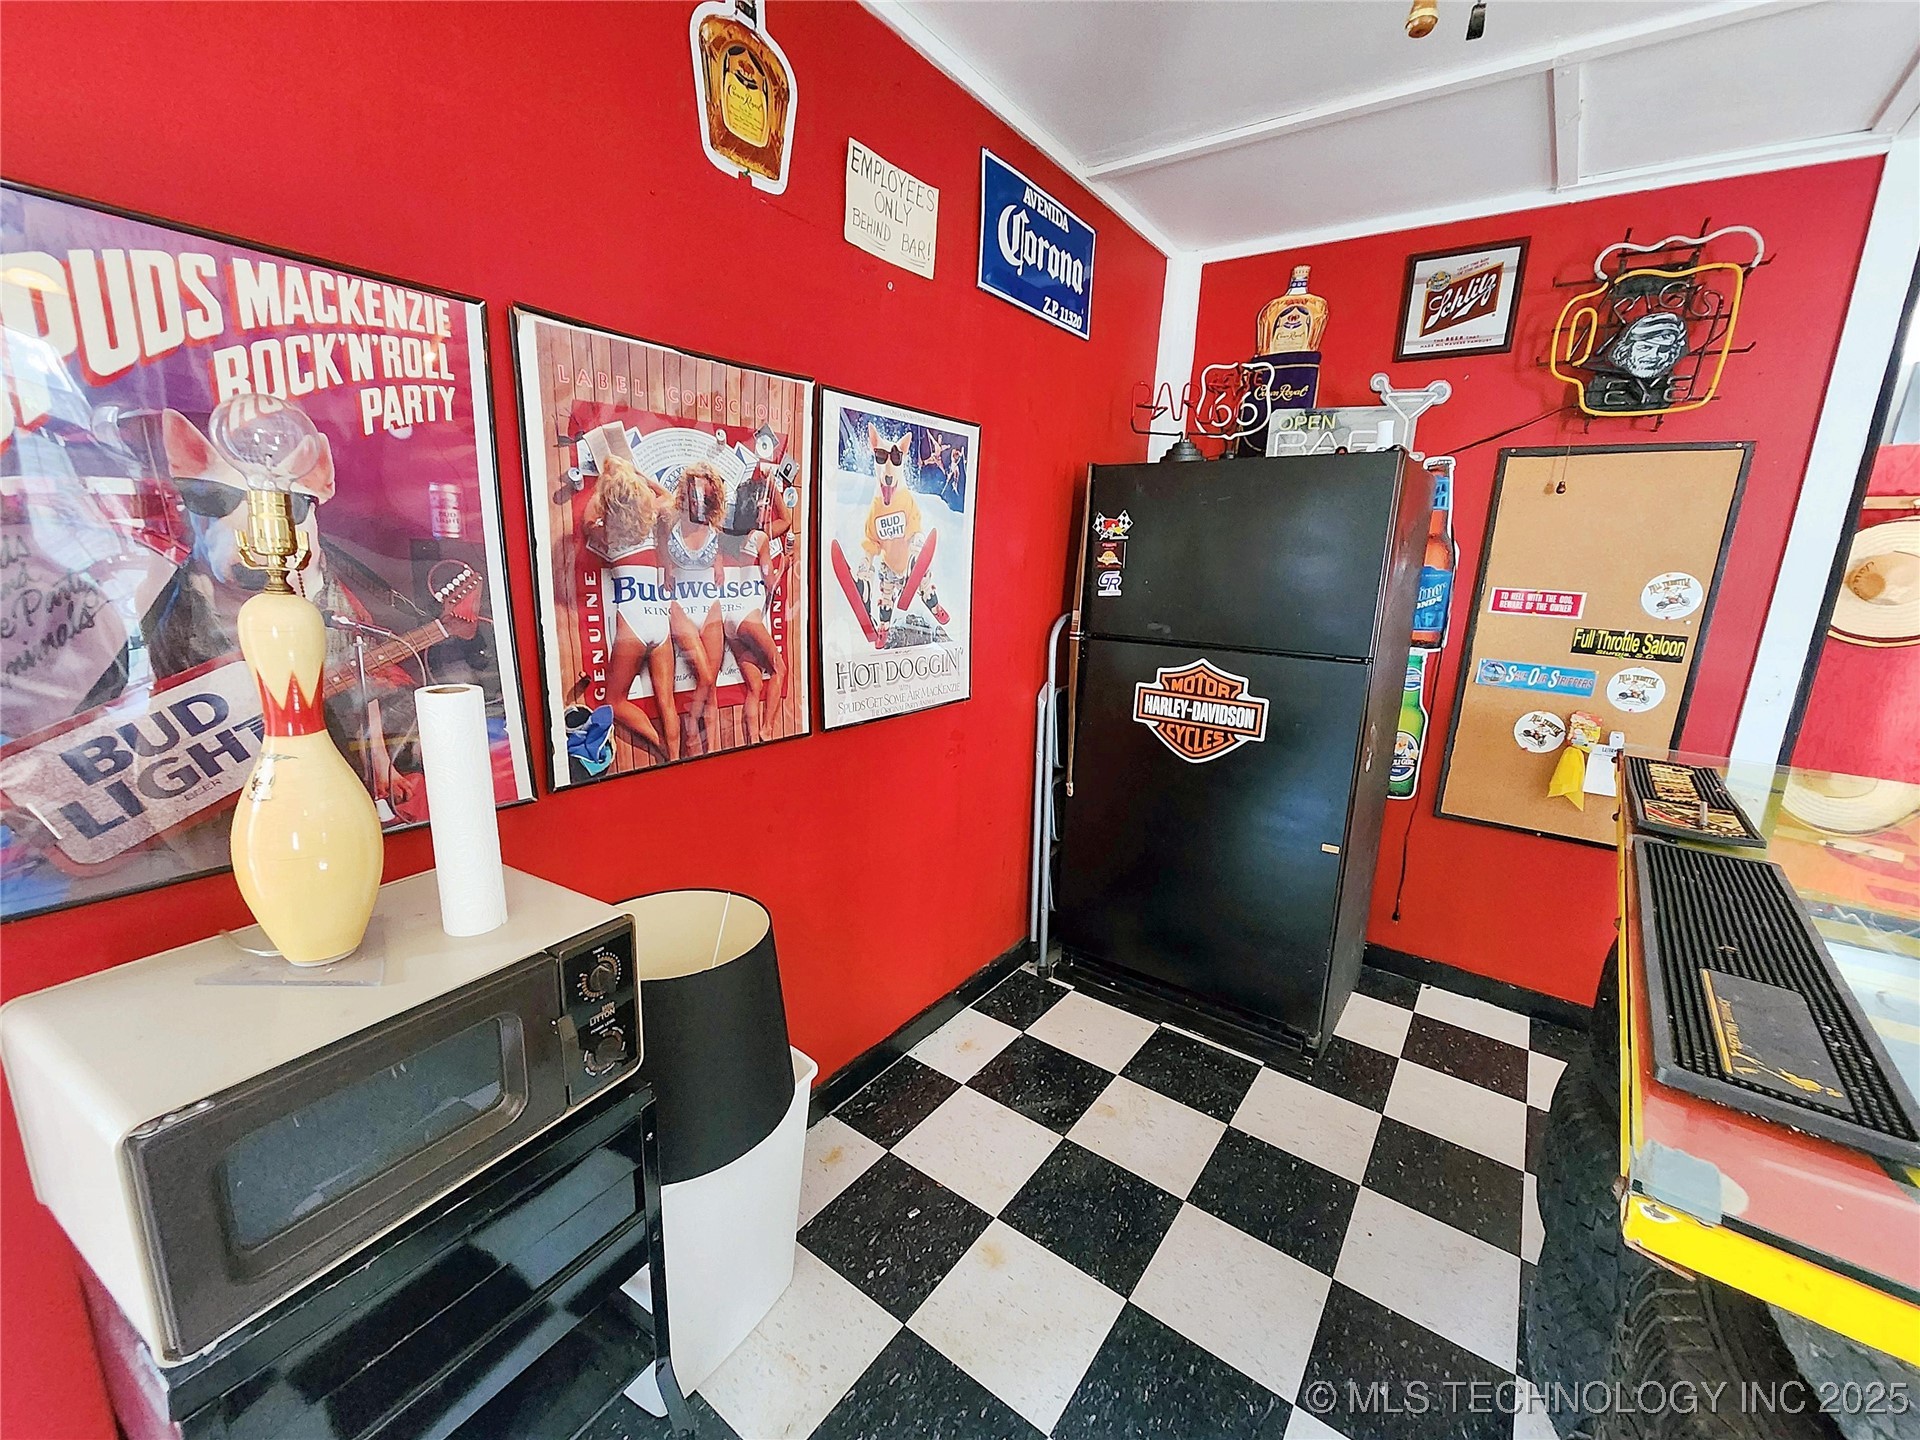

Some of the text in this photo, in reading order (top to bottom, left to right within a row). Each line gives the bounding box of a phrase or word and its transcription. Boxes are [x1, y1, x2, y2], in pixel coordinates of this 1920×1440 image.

[851, 146, 935, 212] EMPLOYEES
[874, 191, 912, 227] ONLY
[1023, 186, 1070, 233] AVENIDA
[853, 207, 931, 261] BEHIND BAR!
[998, 204, 1084, 295] Corona
[1424, 273, 1498, 330] Schlitz
[1059, 306, 1083, 330] 11320
[0, 248, 452, 441] PUDS MACKENZIE
[213, 333, 455, 404] ROCK'N'ROLL
[557, 364, 792, 425] LABEL CONSCIOUS
[1272, 384, 1310, 401] Royal
[1604, 375, 1694, 405] EYE
[360, 386, 456, 436] PARTY
[1208, 391, 1258, 427] 66
[1280, 414, 1336, 431] OPEN
[879, 524, 905, 538] LIGHT
[880, 515, 901, 528] BUD
[611, 576, 766, 604] Budweiser
[1501, 591, 1509, 600] TO
[1511, 592, 1525, 601] HELL
[1527, 593, 1543, 602] WITH
[1545, 594, 1558, 603] THE
[1499, 600, 1573, 613] BEWARE OF THE OWNER
[585, 571, 606, 701] GENUINE
[1573, 628, 1686, 657] Full Throttle Saloon
[835, 647, 964, 691] HOT DOGGIN'
[1547, 669, 1593, 689] STRIPPERS
[1171, 671, 1231, 699] MOTOR
[838, 700, 866, 715] SPUDS
[884, 693, 906, 706] SOME
[1143, 694, 1256, 730] HARLEY-DAVIDSON
[59, 693, 230, 786] BUD
[1165, 723, 1225, 753] CYCLES
[184, 777, 224, 801] BEER
[589, 1005, 616, 1027] LITTON
